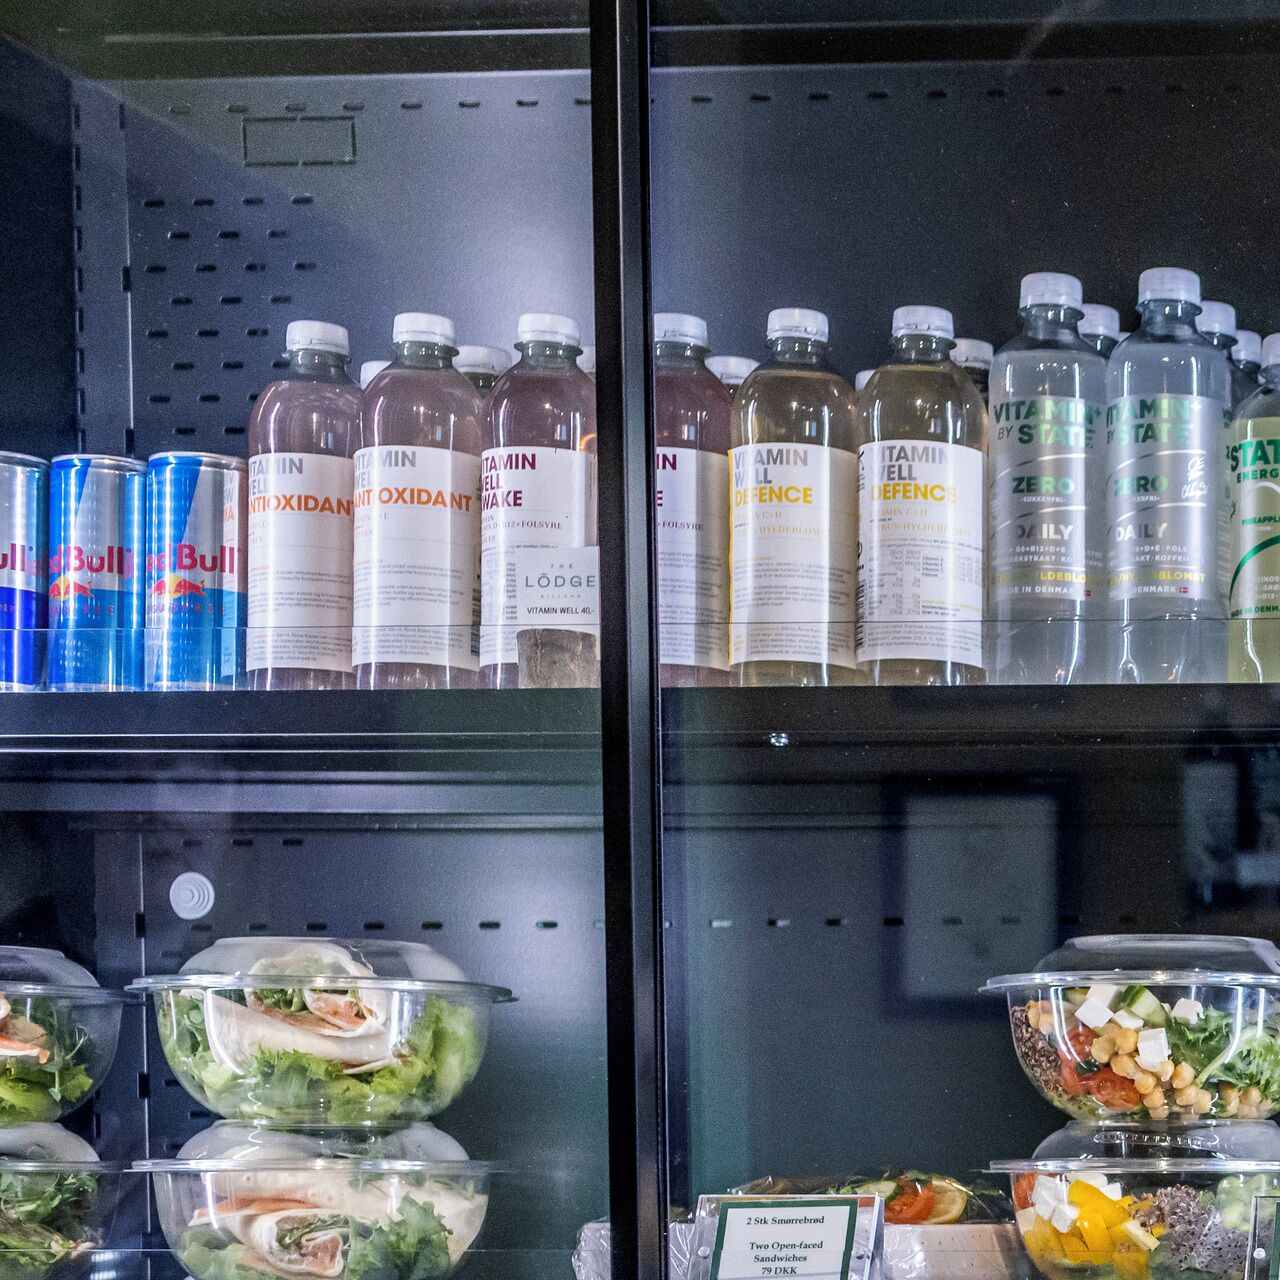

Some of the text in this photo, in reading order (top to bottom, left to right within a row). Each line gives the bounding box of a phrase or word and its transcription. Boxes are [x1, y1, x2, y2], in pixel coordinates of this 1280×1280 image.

[734, 449, 809, 467] VIAMIN
[734, 467, 773, 488] WLL
[1011, 476, 1074, 494] ZERO
[1114, 475, 1168, 494] ZERO
[354, 487, 472, 513] ANTOXIDANT
[735, 486, 813, 506] DEFENCE
[871, 483, 956, 502] DEFENCE
[177, 544, 234, 574] Bull
[527, 606, 558, 615] VITAMIN
[559, 606, 579, 615] WELL
[754, 1217, 769, 1225] Stk
[771, 1216, 825, 1225] Smørrebrød
[749, 1241, 823, 1251] Two Open-faced
[754, 1254, 808, 1263] Sandwiches
[762, 1266, 798, 1275] 79 DKK
